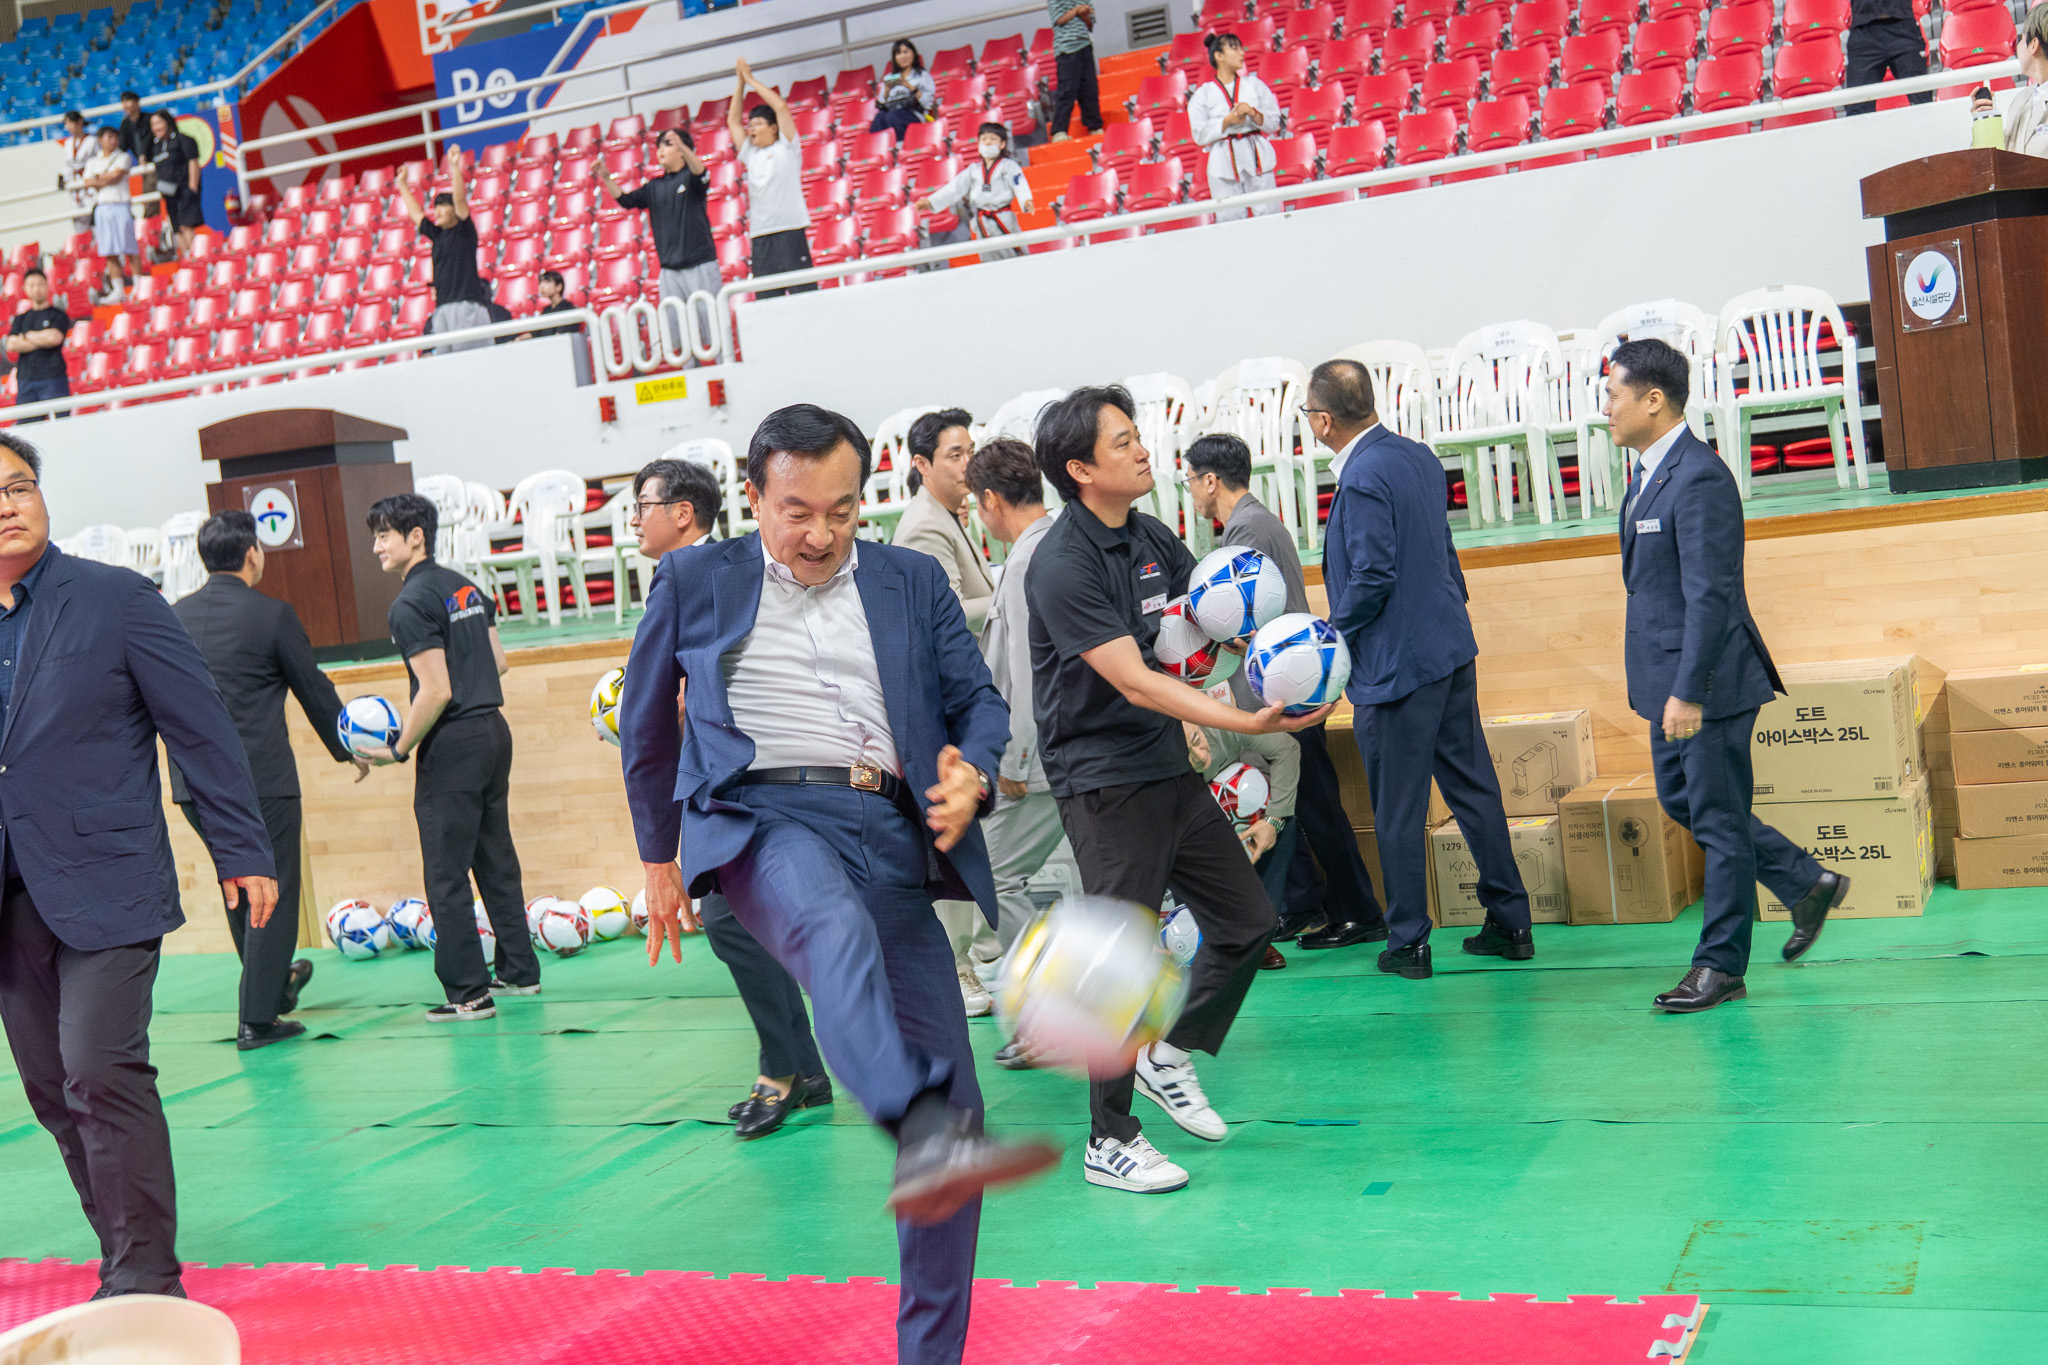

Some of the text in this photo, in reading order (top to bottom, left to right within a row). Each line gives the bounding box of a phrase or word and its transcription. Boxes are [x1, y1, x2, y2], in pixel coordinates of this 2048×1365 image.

[1911, 292, 1951, 307] 울산시설공단
[1211, 687, 1227, 699] Tefal
[1795, 706, 1827, 722] 도트
[1756, 726, 1869, 747] 아이스박스 25L
[1568, 830, 1604, 840] 써큘레이터
[1816, 825, 1848, 840] 도트
[1441, 842, 1462, 851] 1279
[1803, 845, 1891, 862] 스박스 25L
